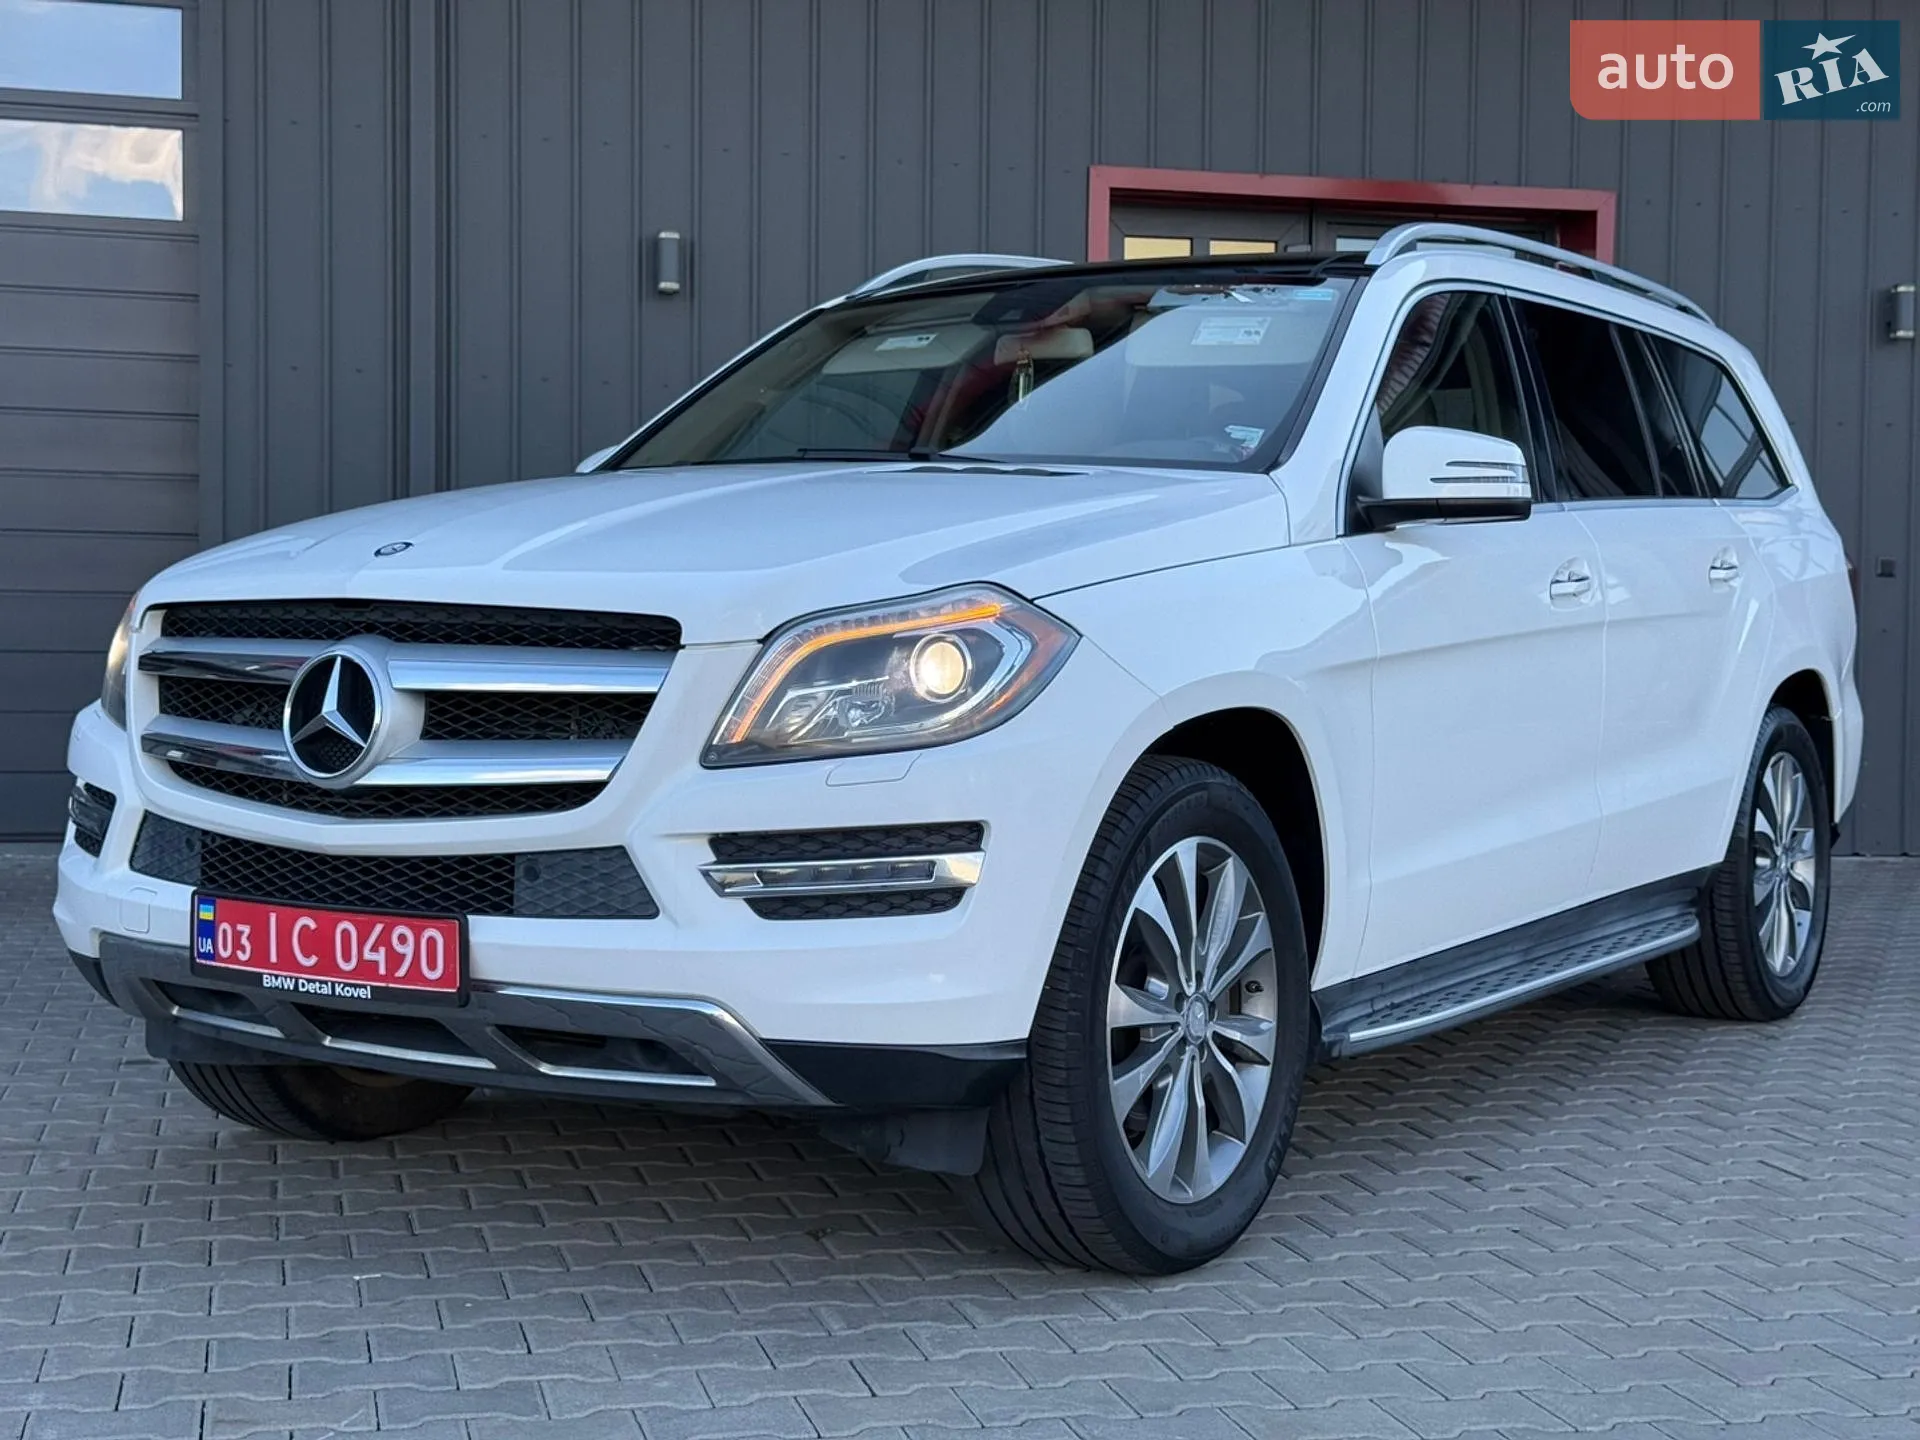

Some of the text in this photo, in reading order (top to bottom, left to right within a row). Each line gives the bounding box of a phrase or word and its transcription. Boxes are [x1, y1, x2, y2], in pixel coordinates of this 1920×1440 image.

[198, 936, 214, 954] UA
[218, 921, 252, 962] 03
[334, 920, 445, 981] 0490
[262, 974, 372, 999] BMW Detal Kovel
